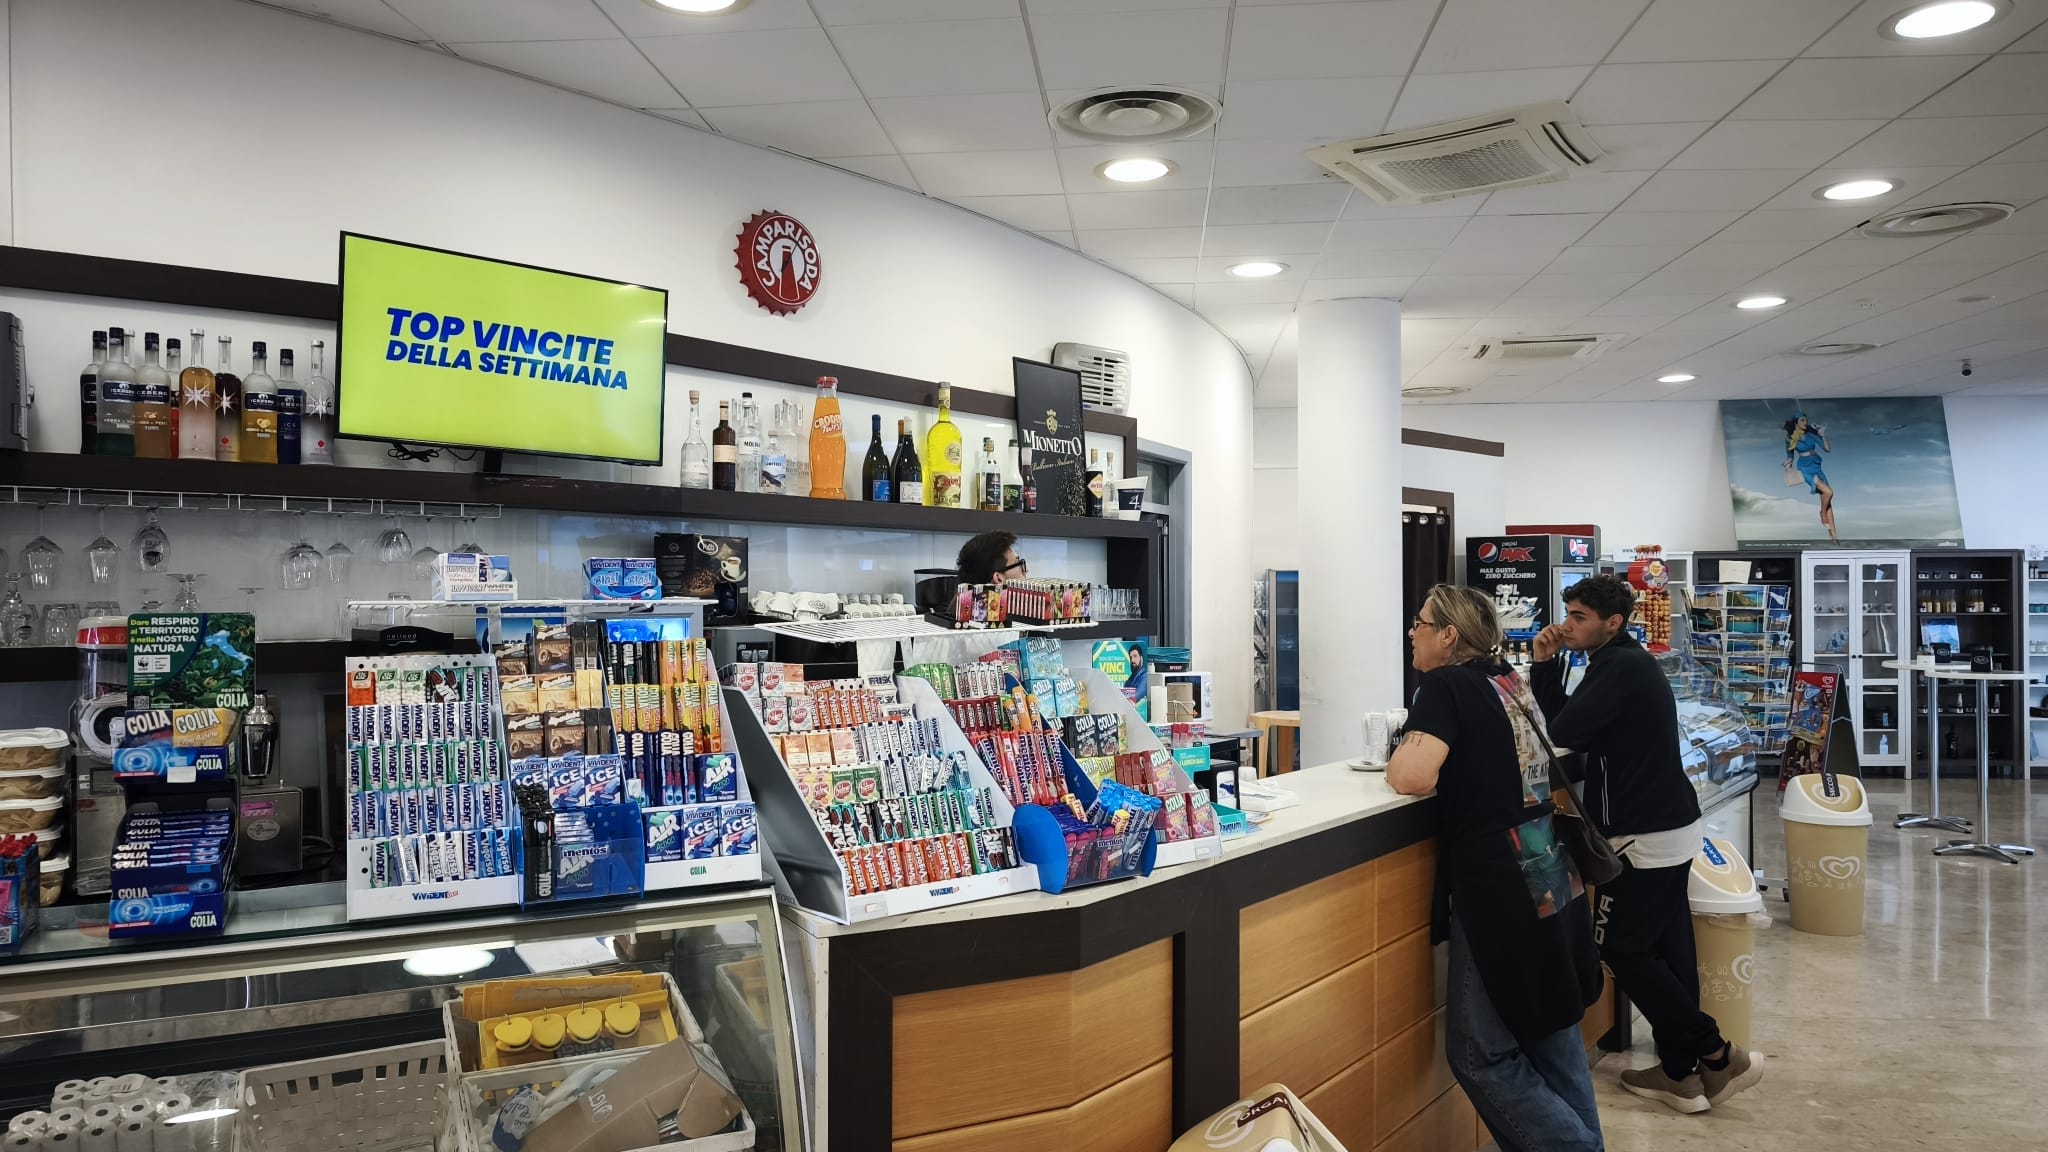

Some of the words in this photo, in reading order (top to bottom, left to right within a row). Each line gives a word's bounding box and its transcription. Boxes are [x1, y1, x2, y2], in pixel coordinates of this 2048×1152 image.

[387, 307, 464, 344] TOP
[473, 320, 614, 365] VINCITE
[386, 340, 471, 371] DELLA
[480, 353, 628, 391] SETTIMANA
[814, 413, 842, 429] CRODI
[151, 617, 199, 626] RESPIRO
[156, 635, 196, 643] NOSTRA
[1046, 638, 1060, 652] OLIA
[134, 644, 184, 653] NATURA
[1100, 662, 1125, 673] VINCI
[869, 675, 892, 685] FRISK
[216, 693, 249, 707] GOLIA
[126, 710, 171, 735] GOLIA
[175, 709, 220, 734] GOLIA
[1075, 714, 1095, 733] GOLIA
[1097, 713, 1117, 731] GOLIA
[632, 732, 643, 757] GOLIA
[683, 731, 694, 756] GOLIA
[196, 758, 222, 770] GOLIA
[1020, 735, 1032, 781] mentos
[553, 769, 581, 786] ICE
[589, 767, 615, 784] ICE
[704, 757, 735, 788] AIR
[1165, 793, 1185, 813] GOLIA
[647, 815, 681, 847] AIR
[688, 819, 714, 837] ICE
[726, 816, 751, 834] ICE
[563, 847, 607, 858] mentos
[690, 866, 707, 876] GOLIA
[538, 872, 552, 896] GOLIA
[118, 887, 149, 899] GOLIA
[190, 915, 217, 928] GOLIA
